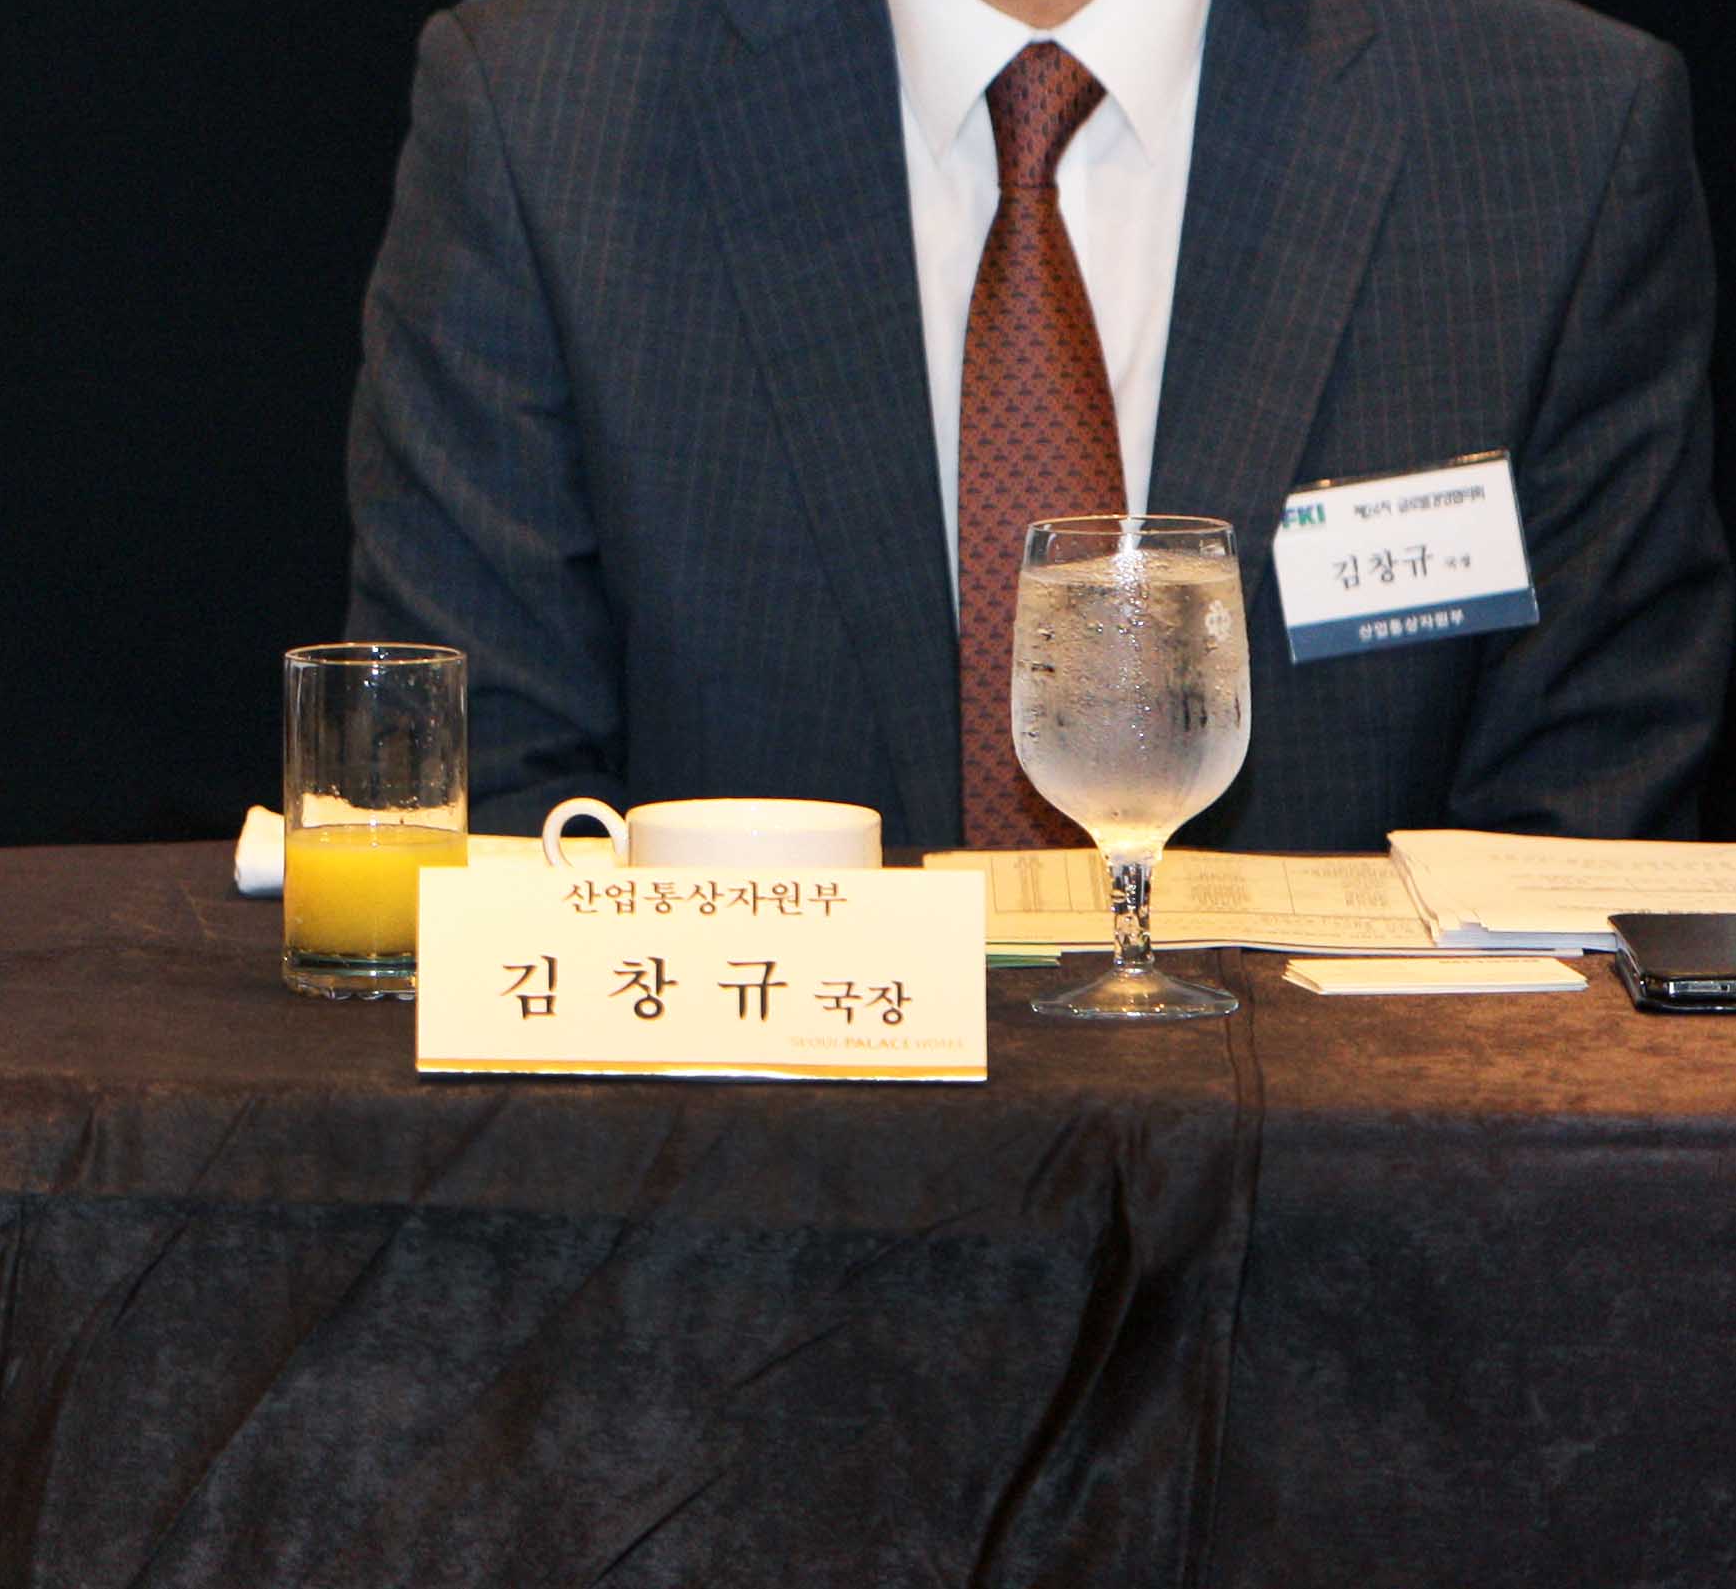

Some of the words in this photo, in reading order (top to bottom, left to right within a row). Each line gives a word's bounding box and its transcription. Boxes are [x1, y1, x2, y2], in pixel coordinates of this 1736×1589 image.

[1281, 502, 1326, 528] FKI
[1332, 544, 1433, 590] 김창규
[563, 879, 849, 918] 산업통상자원부
[813, 980, 913, 1025] 국장
[844, 1036, 911, 1050] PALACE
